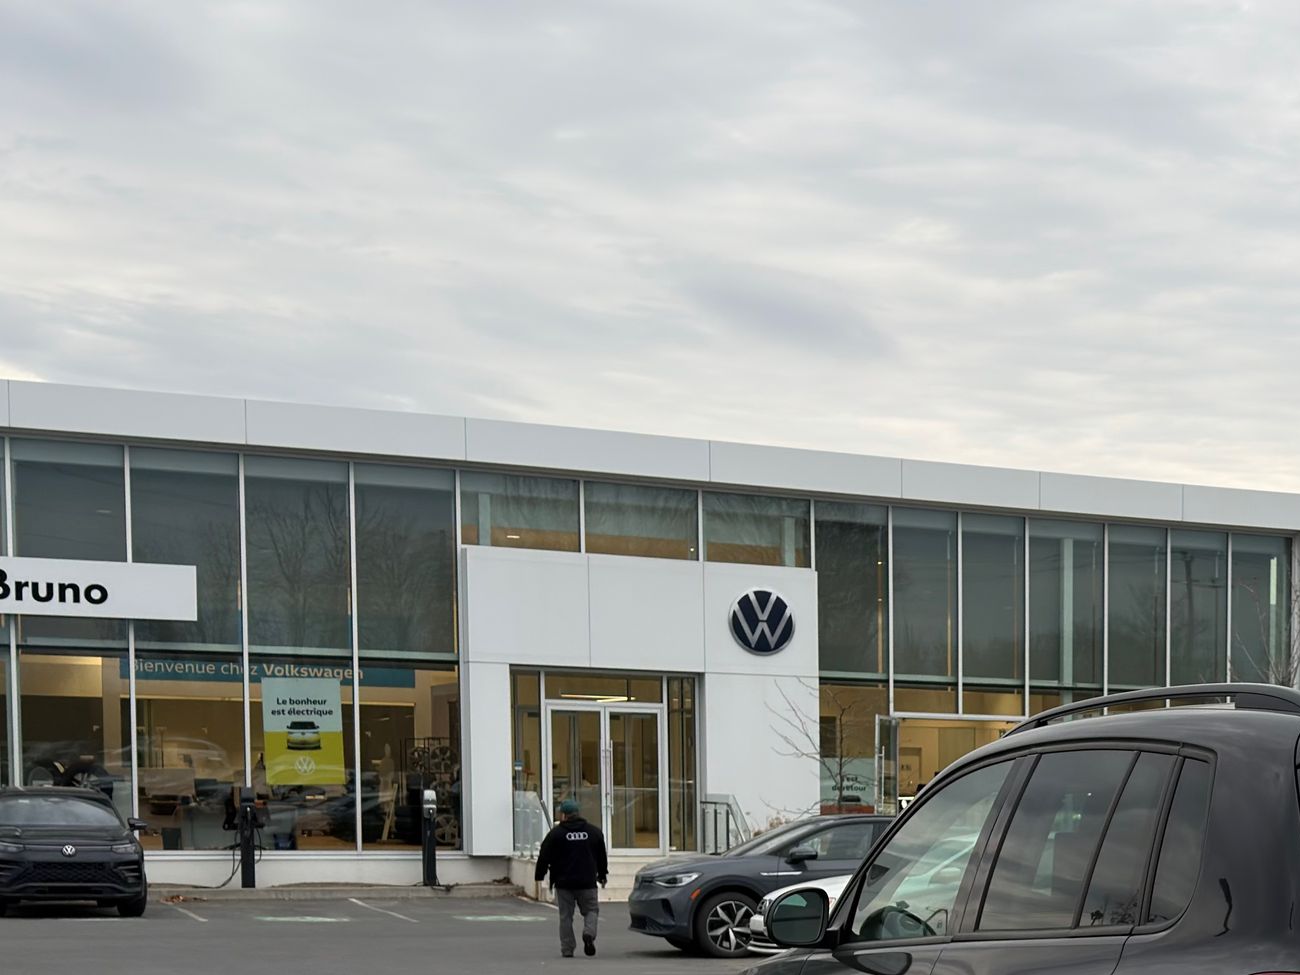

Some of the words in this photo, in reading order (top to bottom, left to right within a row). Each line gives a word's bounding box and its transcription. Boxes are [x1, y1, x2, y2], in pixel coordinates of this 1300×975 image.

[276, 697, 287, 705] Le
[289, 697, 327, 706] bonheur
[271, 708, 286, 716] est
[287, 707, 334, 717] électrique
